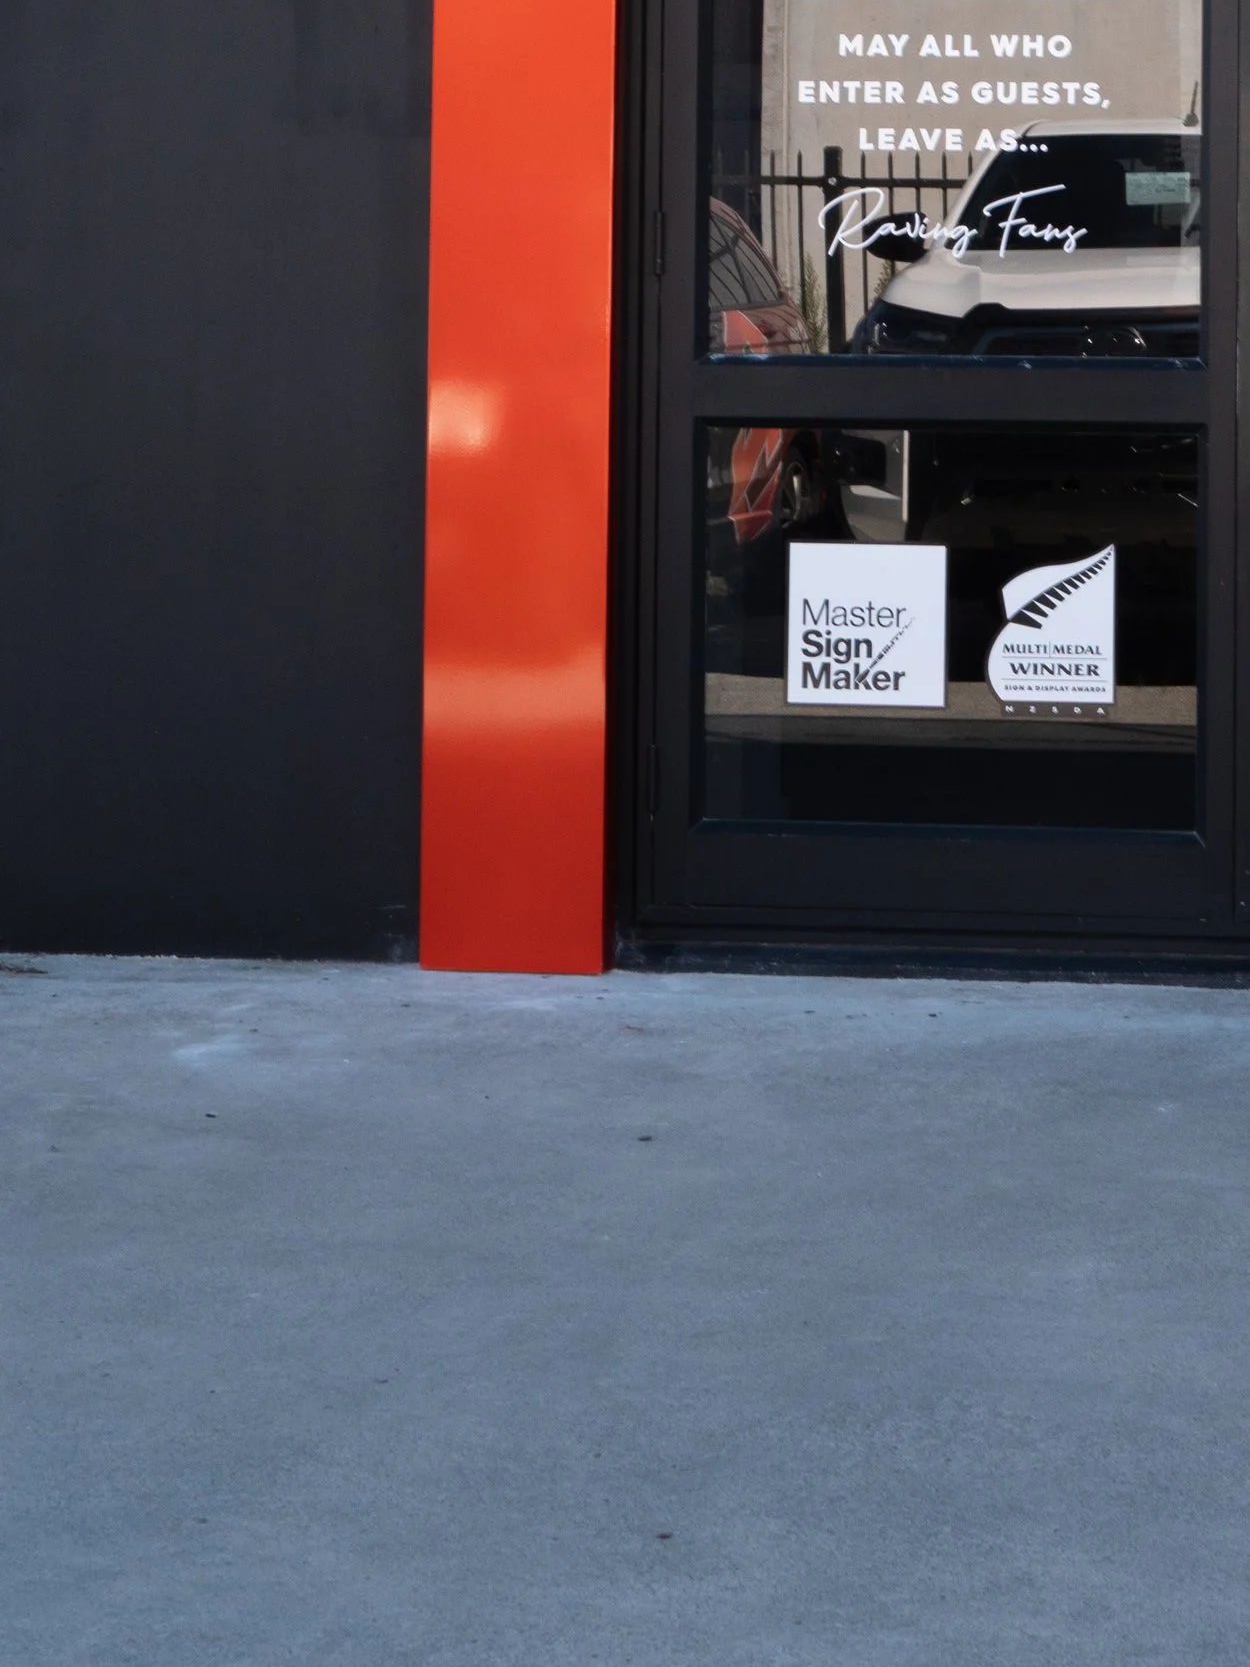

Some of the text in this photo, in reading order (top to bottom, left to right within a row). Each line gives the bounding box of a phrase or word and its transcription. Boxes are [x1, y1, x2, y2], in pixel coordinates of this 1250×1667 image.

[839, 34, 1073, 58] MAY ALL WHO
[798, 80, 1111, 108] ENTER AS GUESTS,
[860, 128, 1049, 152] LEAVE AS...
[818, 187, 977, 259] Raving
[982, 184, 1088, 259] Fans
[802, 597, 906, 629] Master
[801, 630, 873, 664] Sign
[801, 662, 906, 691] Maker
[1010, 662, 1100, 676] WINNER
[1072, 685, 1106, 693] AWARDS
